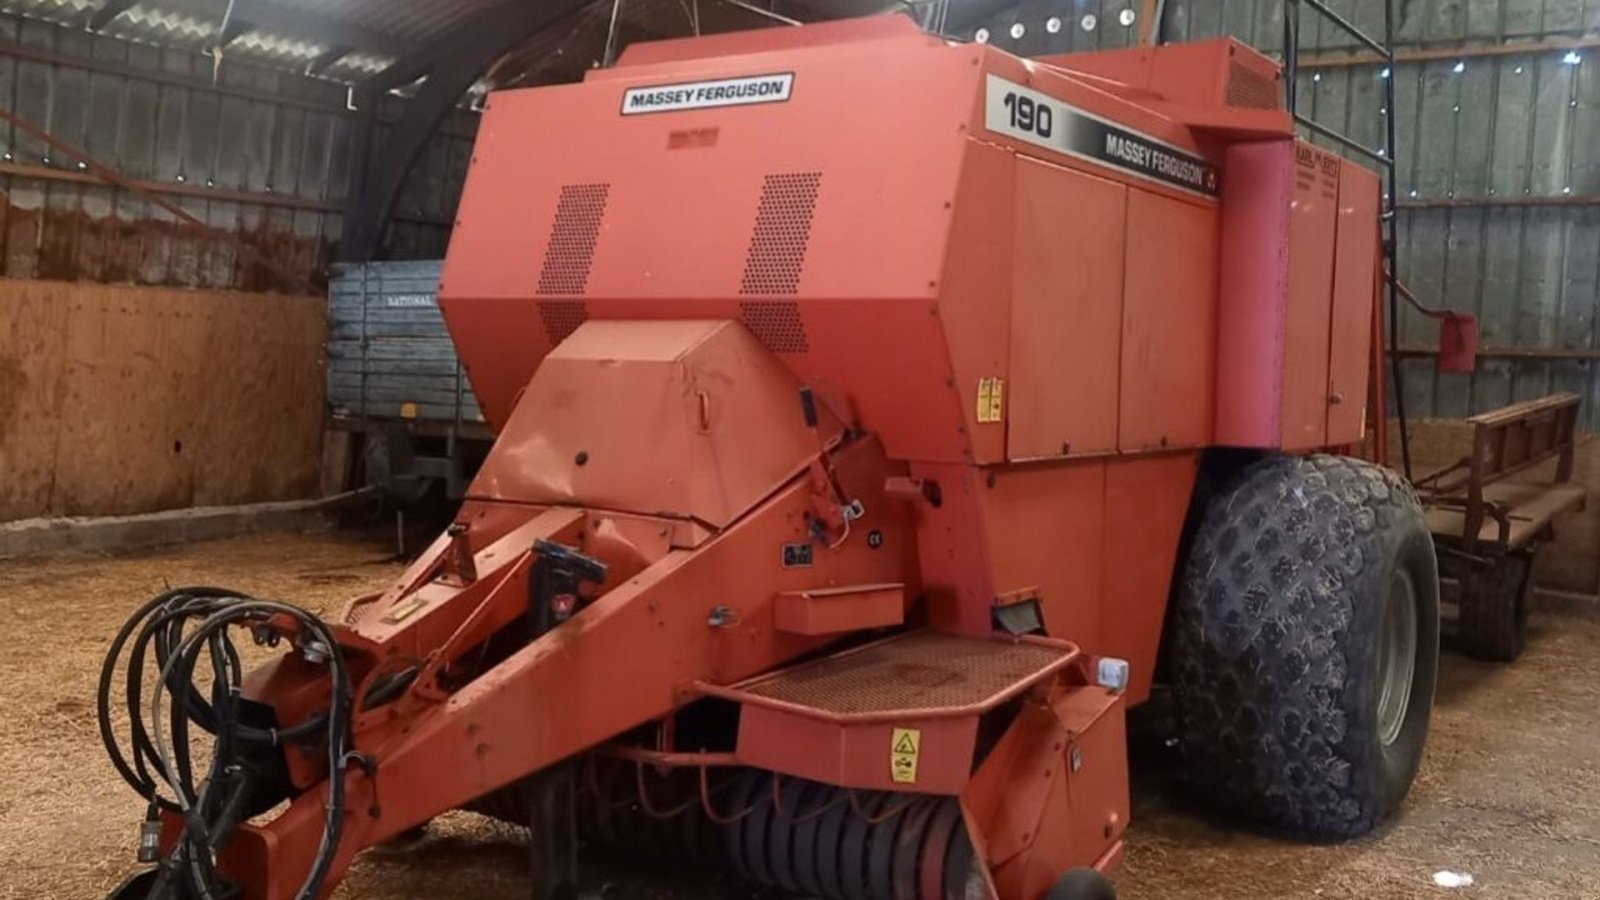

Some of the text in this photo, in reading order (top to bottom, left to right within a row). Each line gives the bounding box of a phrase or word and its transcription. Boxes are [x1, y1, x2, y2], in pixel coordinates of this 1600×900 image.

[630, 81, 784, 108] MASSEY FERGUSON
[1004, 92, 1052, 138] 190
[1106, 134, 1203, 185] MASSEY FERGUSON
